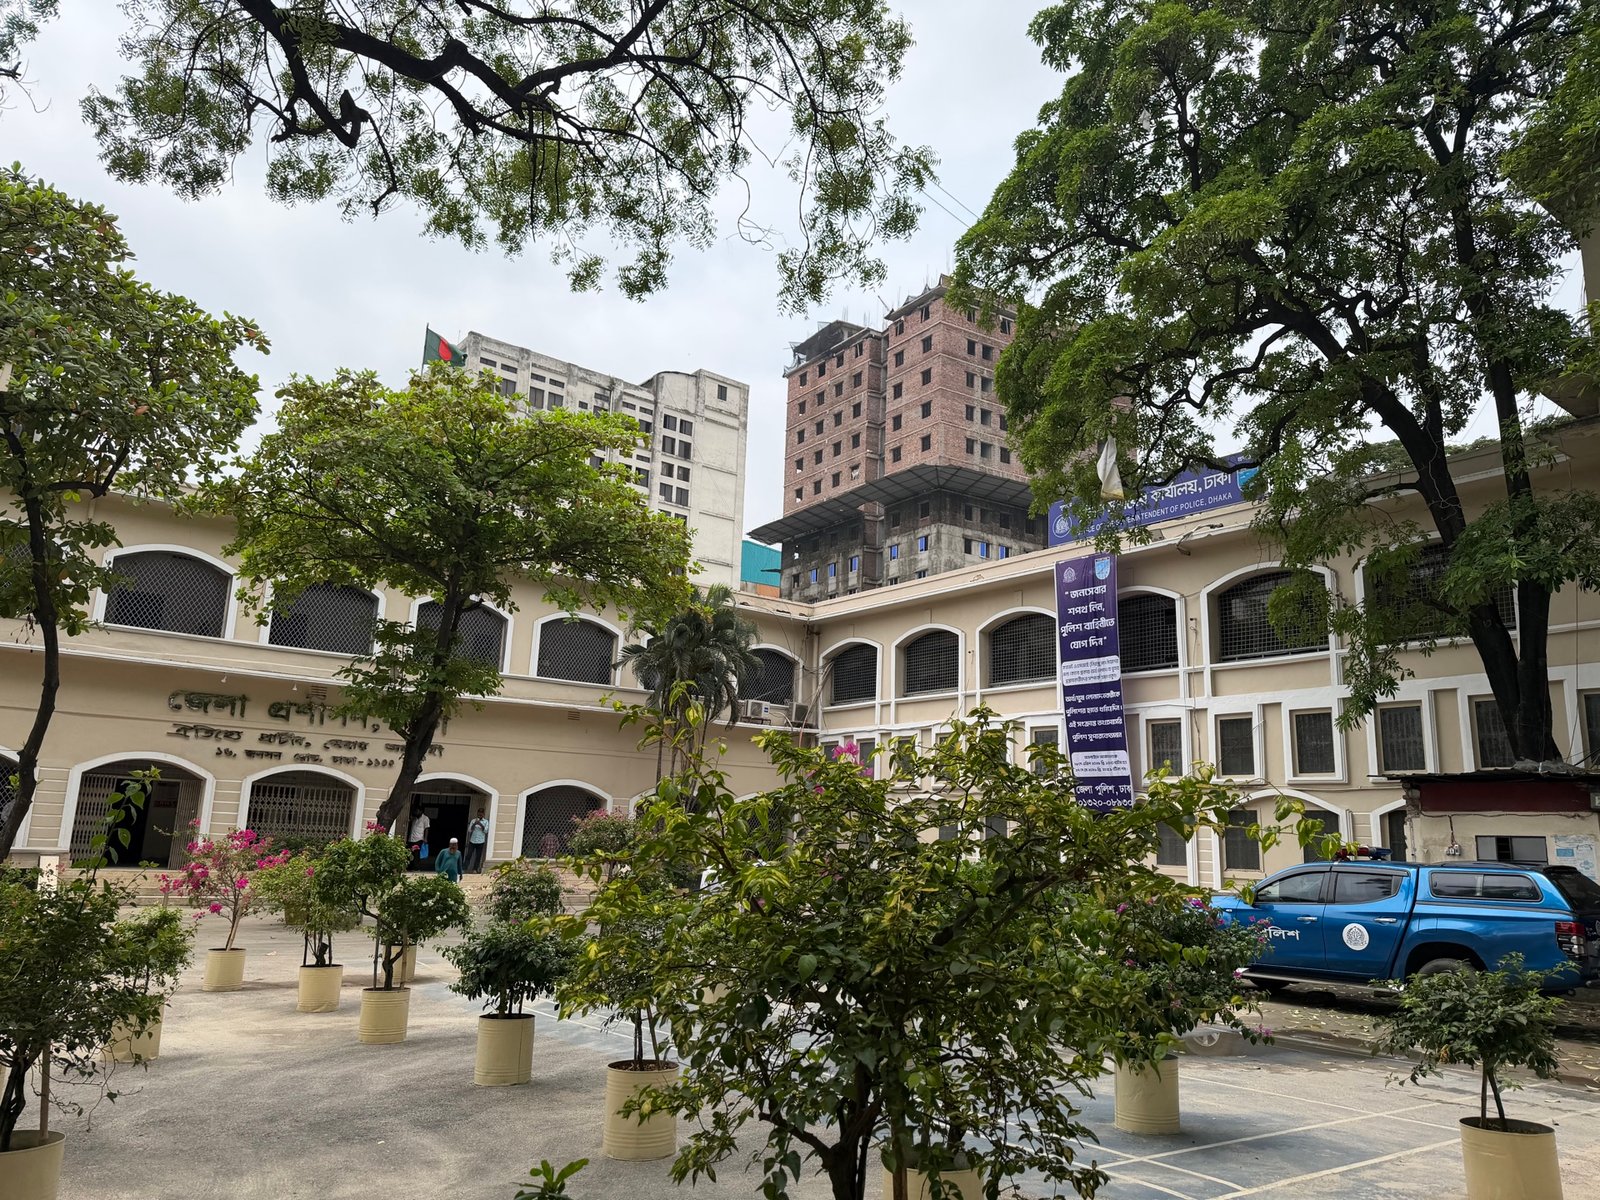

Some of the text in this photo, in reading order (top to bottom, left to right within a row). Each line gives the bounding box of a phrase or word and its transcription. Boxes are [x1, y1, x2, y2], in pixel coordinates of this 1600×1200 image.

[1203, 472, 1231, 490] ঢাকা
[1170, 504, 1179, 514] OF
[1208, 492, 1233, 504] DHAKA
[1067, 606, 1088, 616] শপথ
[1060, 617, 1115, 637] পুলিশ বাহিনীতে
[1070, 639, 1088, 650] যোগ
[168, 689, 249, 718] জেলা
[1072, 732, 1087, 743] পুলিশ
[244, 748, 282, 761] জনসন
[1076, 785, 1093, 795] জেলা
